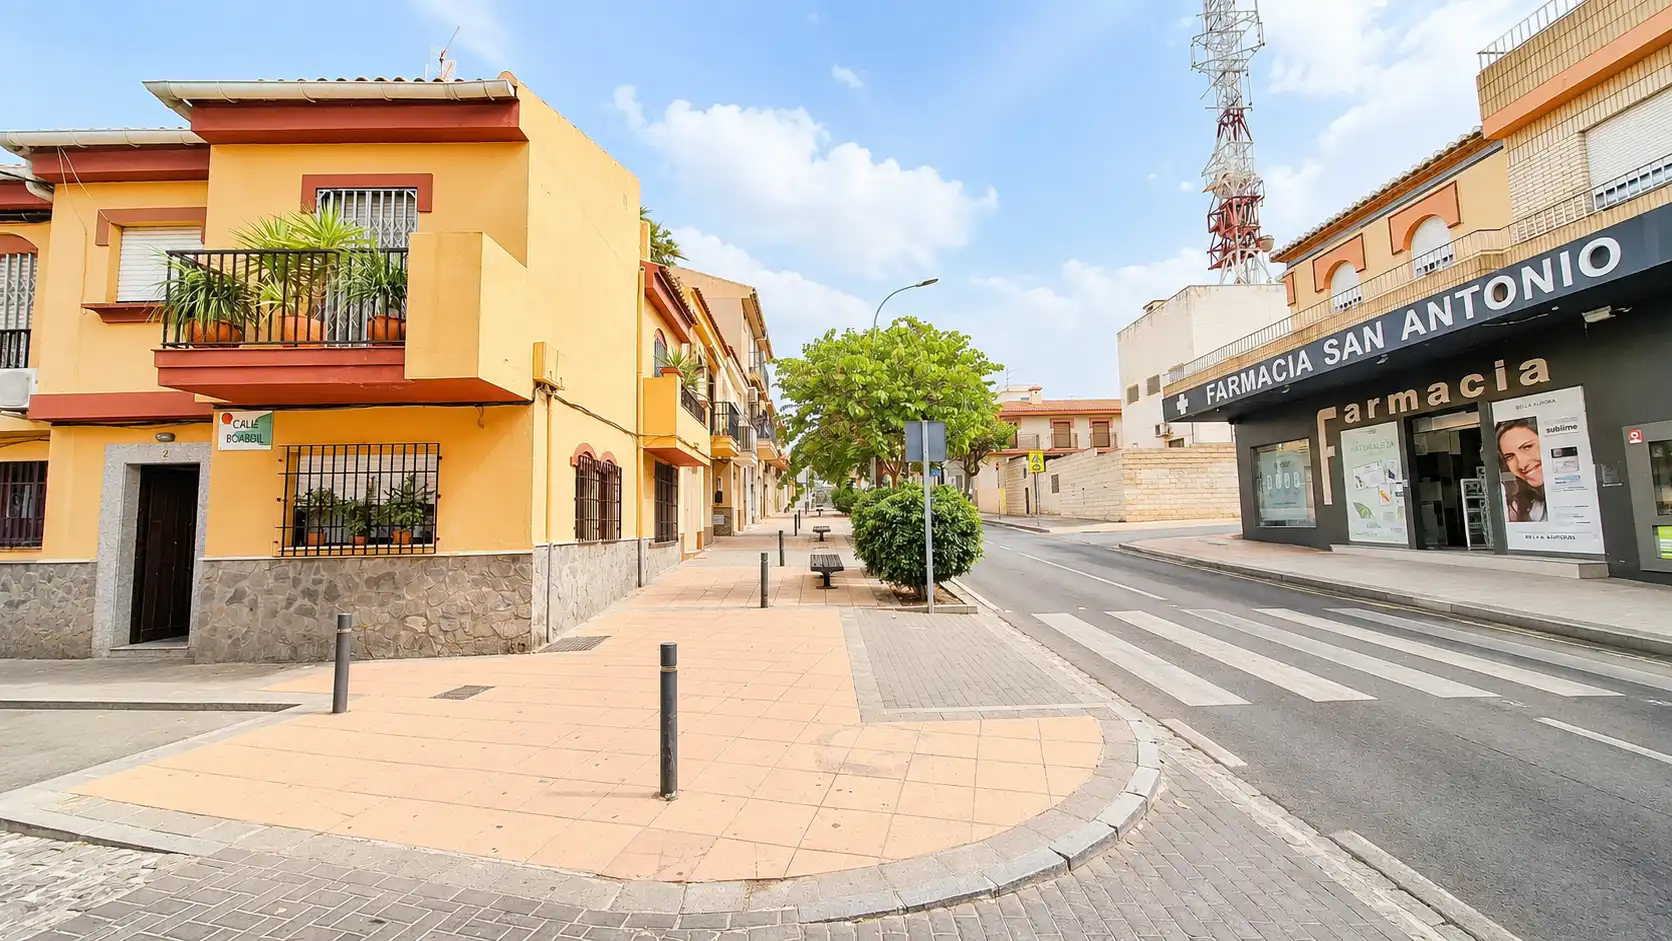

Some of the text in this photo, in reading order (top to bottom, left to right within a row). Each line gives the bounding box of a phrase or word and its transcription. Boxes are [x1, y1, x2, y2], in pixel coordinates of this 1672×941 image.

[1205, 236, 1622, 406] FARMACIA SAN ANTONIO
[233, 419, 259, 429] CALLE
[1546, 424, 1579, 434] sublime
[1316, 357, 1552, 506] Farmacia
[163, 450, 168, 458] 2
